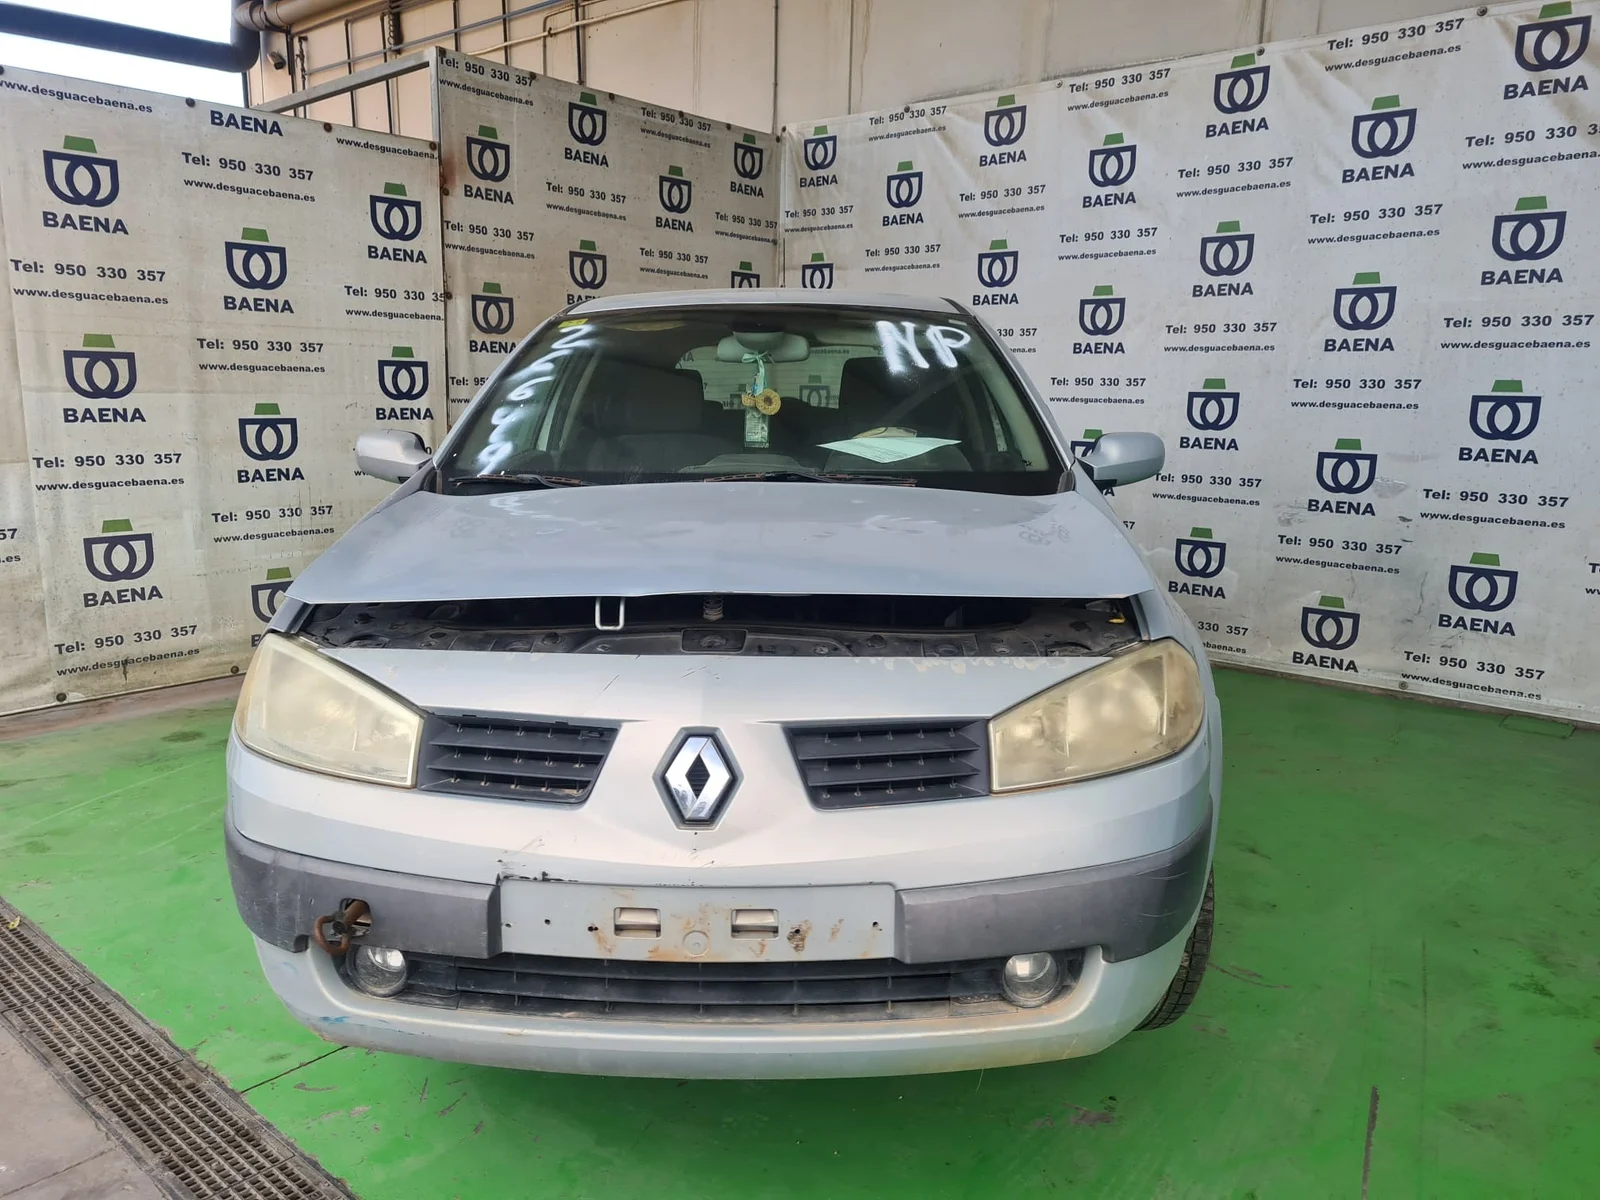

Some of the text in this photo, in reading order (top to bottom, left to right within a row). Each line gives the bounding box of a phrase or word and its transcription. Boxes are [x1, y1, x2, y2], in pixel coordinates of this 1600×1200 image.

[1328, 18, 1464, 50] Tel: 950 330 357
[1325, 44, 1461, 71] www.desguacebaena.es
[439, 56, 534, 87] Tel: 950 330 357
[1069, 68, 1170, 93] Tel: 950 330 357
[1504, 75, 1588, 100] BAENA
[439, 78, 534, 106] www.desguacebaena.es
[1068, 91, 1168, 111] www.desguacebaena.es
[211, 110, 283, 136] BAENA
[1206, 117, 1269, 138] BAENA
[1465, 135, 1494, 147] Tel:
[1505, 130, 1535, 143] 950
[1546, 126, 1577, 139] 330
[565, 147, 609, 167] BAENA
[979, 150, 1026, 167] BAENA
[182, 152, 313, 180] Tel: 950 330 357
[1178, 157, 1293, 178] Tel: 950 330 357
[1342, 163, 1414, 183] BAENA
[800, 174, 838, 187] BAENA
[1177, 181, 1291, 197] www.desguacebaena.es
[184, 180, 315, 202] www.desguacebaena.es
[464, 184, 514, 204] BAENA
[546, 182, 626, 203] Tel: 950 330 357
[730, 181, 764, 198] BAENA
[960, 185, 1046, 201] Tel: 950 330 357
[1083, 192, 1136, 208] BAENA
[546, 204, 626, 221] www.desguacebaena.es
[785, 205, 853, 218] Tel: 950 330 357
[883, 213, 923, 226] BAENA
[958, 206, 1044, 218] www.desguacebaena.es
[1310, 204, 1443, 224] Tel: 950 330 357
[43, 211, 128, 235] BAENA
[656, 217, 693, 232] BAENA
[784, 224, 853, 233] www.desguacebaena.es
[1060, 227, 1157, 243] Tel: 950 330 357
[1308, 230, 1440, 244] www.desguacebaena.es
[368, 245, 427, 263] BAENA
[865, 244, 940, 257] Tel: 950 330 357
[1058, 249, 1156, 260] www.desguacebaena.es
[10, 259, 165, 282] Tel: 950 330 357
[865, 263, 940, 272] www.desguacebaena.es
[1481, 268, 1563, 285] BAENA
[13, 288, 168, 304] www.desguacebaena.es
[344, 286, 425, 301] Tel: 950 330
[1193, 282, 1253, 297] BAENA
[224, 296, 294, 313] BAENA
[973, 293, 1018, 305] BAENA
[1166, 323, 1277, 334] Tel: 950 330 357
[1444, 315, 1594, 328] Tel: 950 330 357
[1073, 342, 1125, 354] BAENA
[1164, 344, 1275, 353] www.desguacebaena.es
[1324, 338, 1394, 352] BAENA
[1441, 340, 1590, 350] www.desguacebaena.es
[450, 377, 468, 385] Tel:
[1051, 377, 1146, 386] Tel: 950 330 357
[1049, 396, 1144, 404] www.desguacebaena.es
[63, 408, 146, 423] BAENA
[376, 408, 434, 420] BAENA
[1180, 437, 1238, 450] BAENA
[32, 453, 181, 468] Tel: 950 330 357
[1459, 447, 1538, 464] BAENA
[237, 468, 304, 483] BAENA
[36, 478, 184, 491] www.desguacebaena.es
[1423, 489, 1569, 507] Tel: 950 330 357
[211, 505, 333, 522] Tel: 950 330 357
[1308, 499, 1375, 516] BAENA
[1420, 513, 1565, 528] www.desguacebaena.es
[214, 528, 334, 543] www.desguacebaena.es
[1278, 535, 1402, 554] Tel: 950 330 357
[1276, 556, 1399, 574] www.desguacebaena.es
[83, 586, 163, 607] BAENA
[1168, 581, 1225, 599] BAENA
[1198, 621, 1248, 636] 330 357
[1438, 614, 1515, 636] BAENA
[54, 625, 197, 654] Tel: 950 330 357
[57, 648, 200, 676] www.desguacebaena.es
[1293, 651, 1358, 673] BAENA
[1404, 651, 1545, 679] Tel: 950 330 357
[1401, 672, 1542, 700] www.desguacebaena.es
